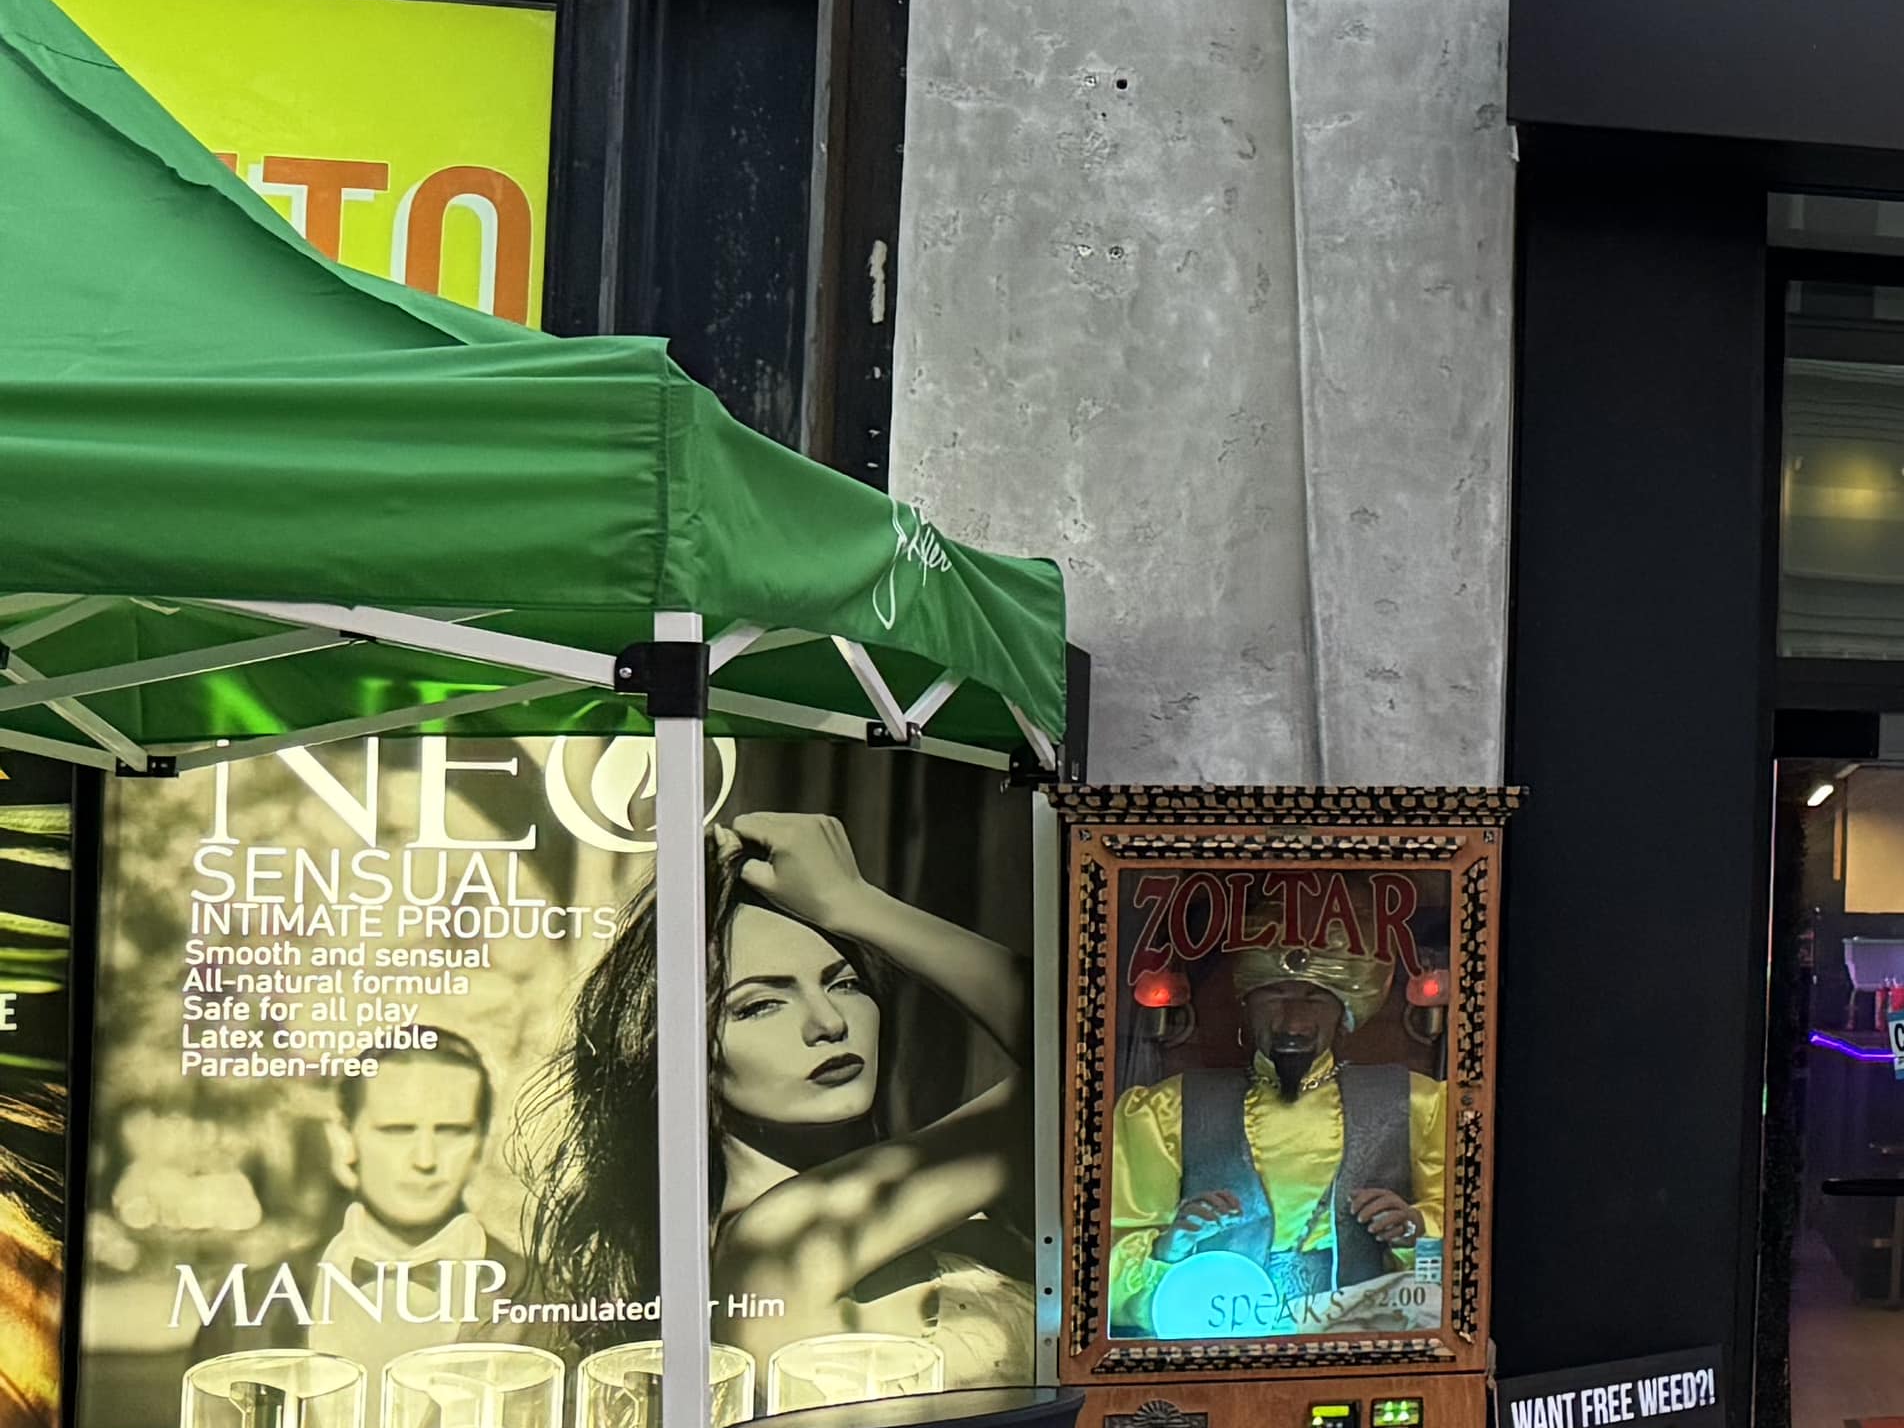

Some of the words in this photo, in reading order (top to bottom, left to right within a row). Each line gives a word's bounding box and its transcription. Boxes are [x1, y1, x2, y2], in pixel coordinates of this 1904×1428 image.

[190, 845, 547, 908] SENSUAL
[190, 902, 384, 938] INTIMATE
[397, 905, 617, 941] PRODUCTS
[1127, 871, 1424, 986] ZOLTAR
[185, 940, 301, 967] Smooth
[311, 942, 361, 967] and
[375, 944, 491, 969] sensual
[183, 969, 344, 995] All-natural
[352, 971, 469, 996] formula
[183, 996, 250, 1022] Safe
[260, 998, 302, 1022] for
[312, 999, 346, 1023] all
[357, 999, 418, 1028] play
[181, 1025, 264, 1050] Latex
[273, 1026, 438, 1054] compatible
[181, 1052, 379, 1077] Paraben-free
[168, 1259, 506, 1328] MANUP
[493, 1298, 661, 1324] Formulated
[728, 1293, 785, 1318] Him
[1581, 1382, 1635, 1428] FREE
[1638, 1368, 1716, 1418] WEED?!
